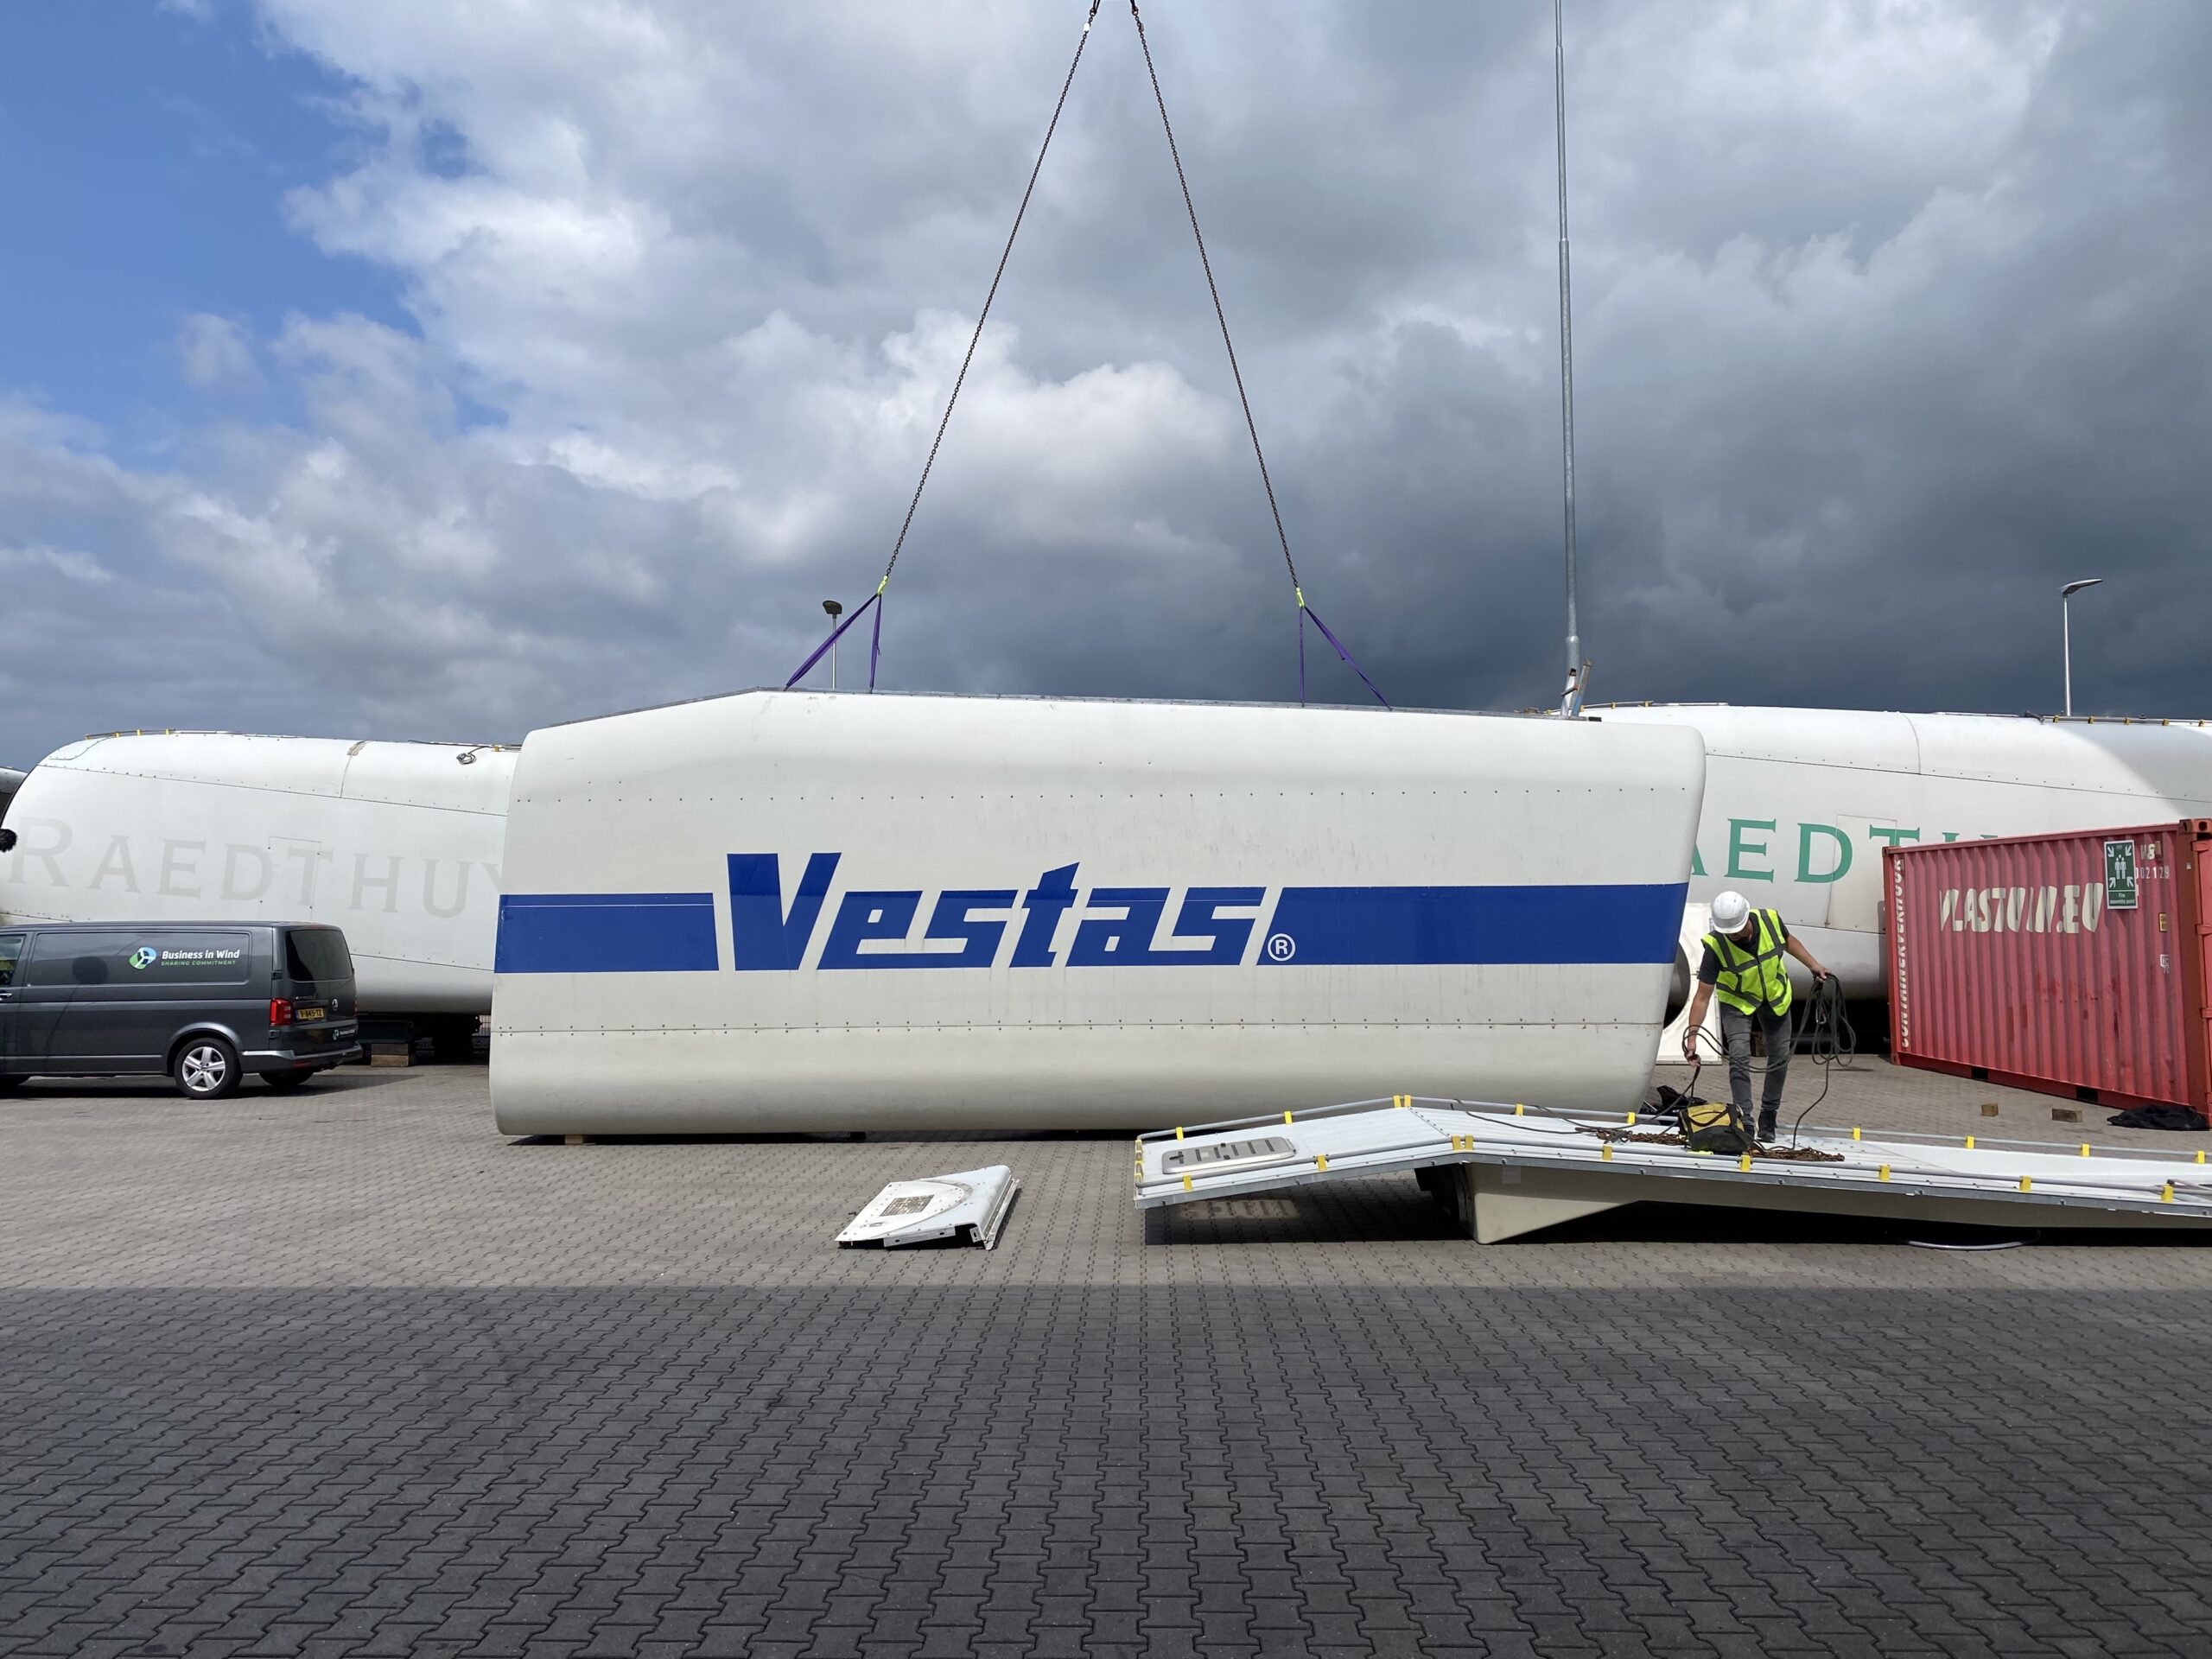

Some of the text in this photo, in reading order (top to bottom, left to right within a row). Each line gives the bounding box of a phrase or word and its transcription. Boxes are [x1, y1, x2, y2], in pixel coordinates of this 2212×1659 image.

[727, 852, 1268, 970] Vestas
[1939, 882, 2104, 933] VLASTUIN.EU
[162, 950, 240, 959] Business in Wind
